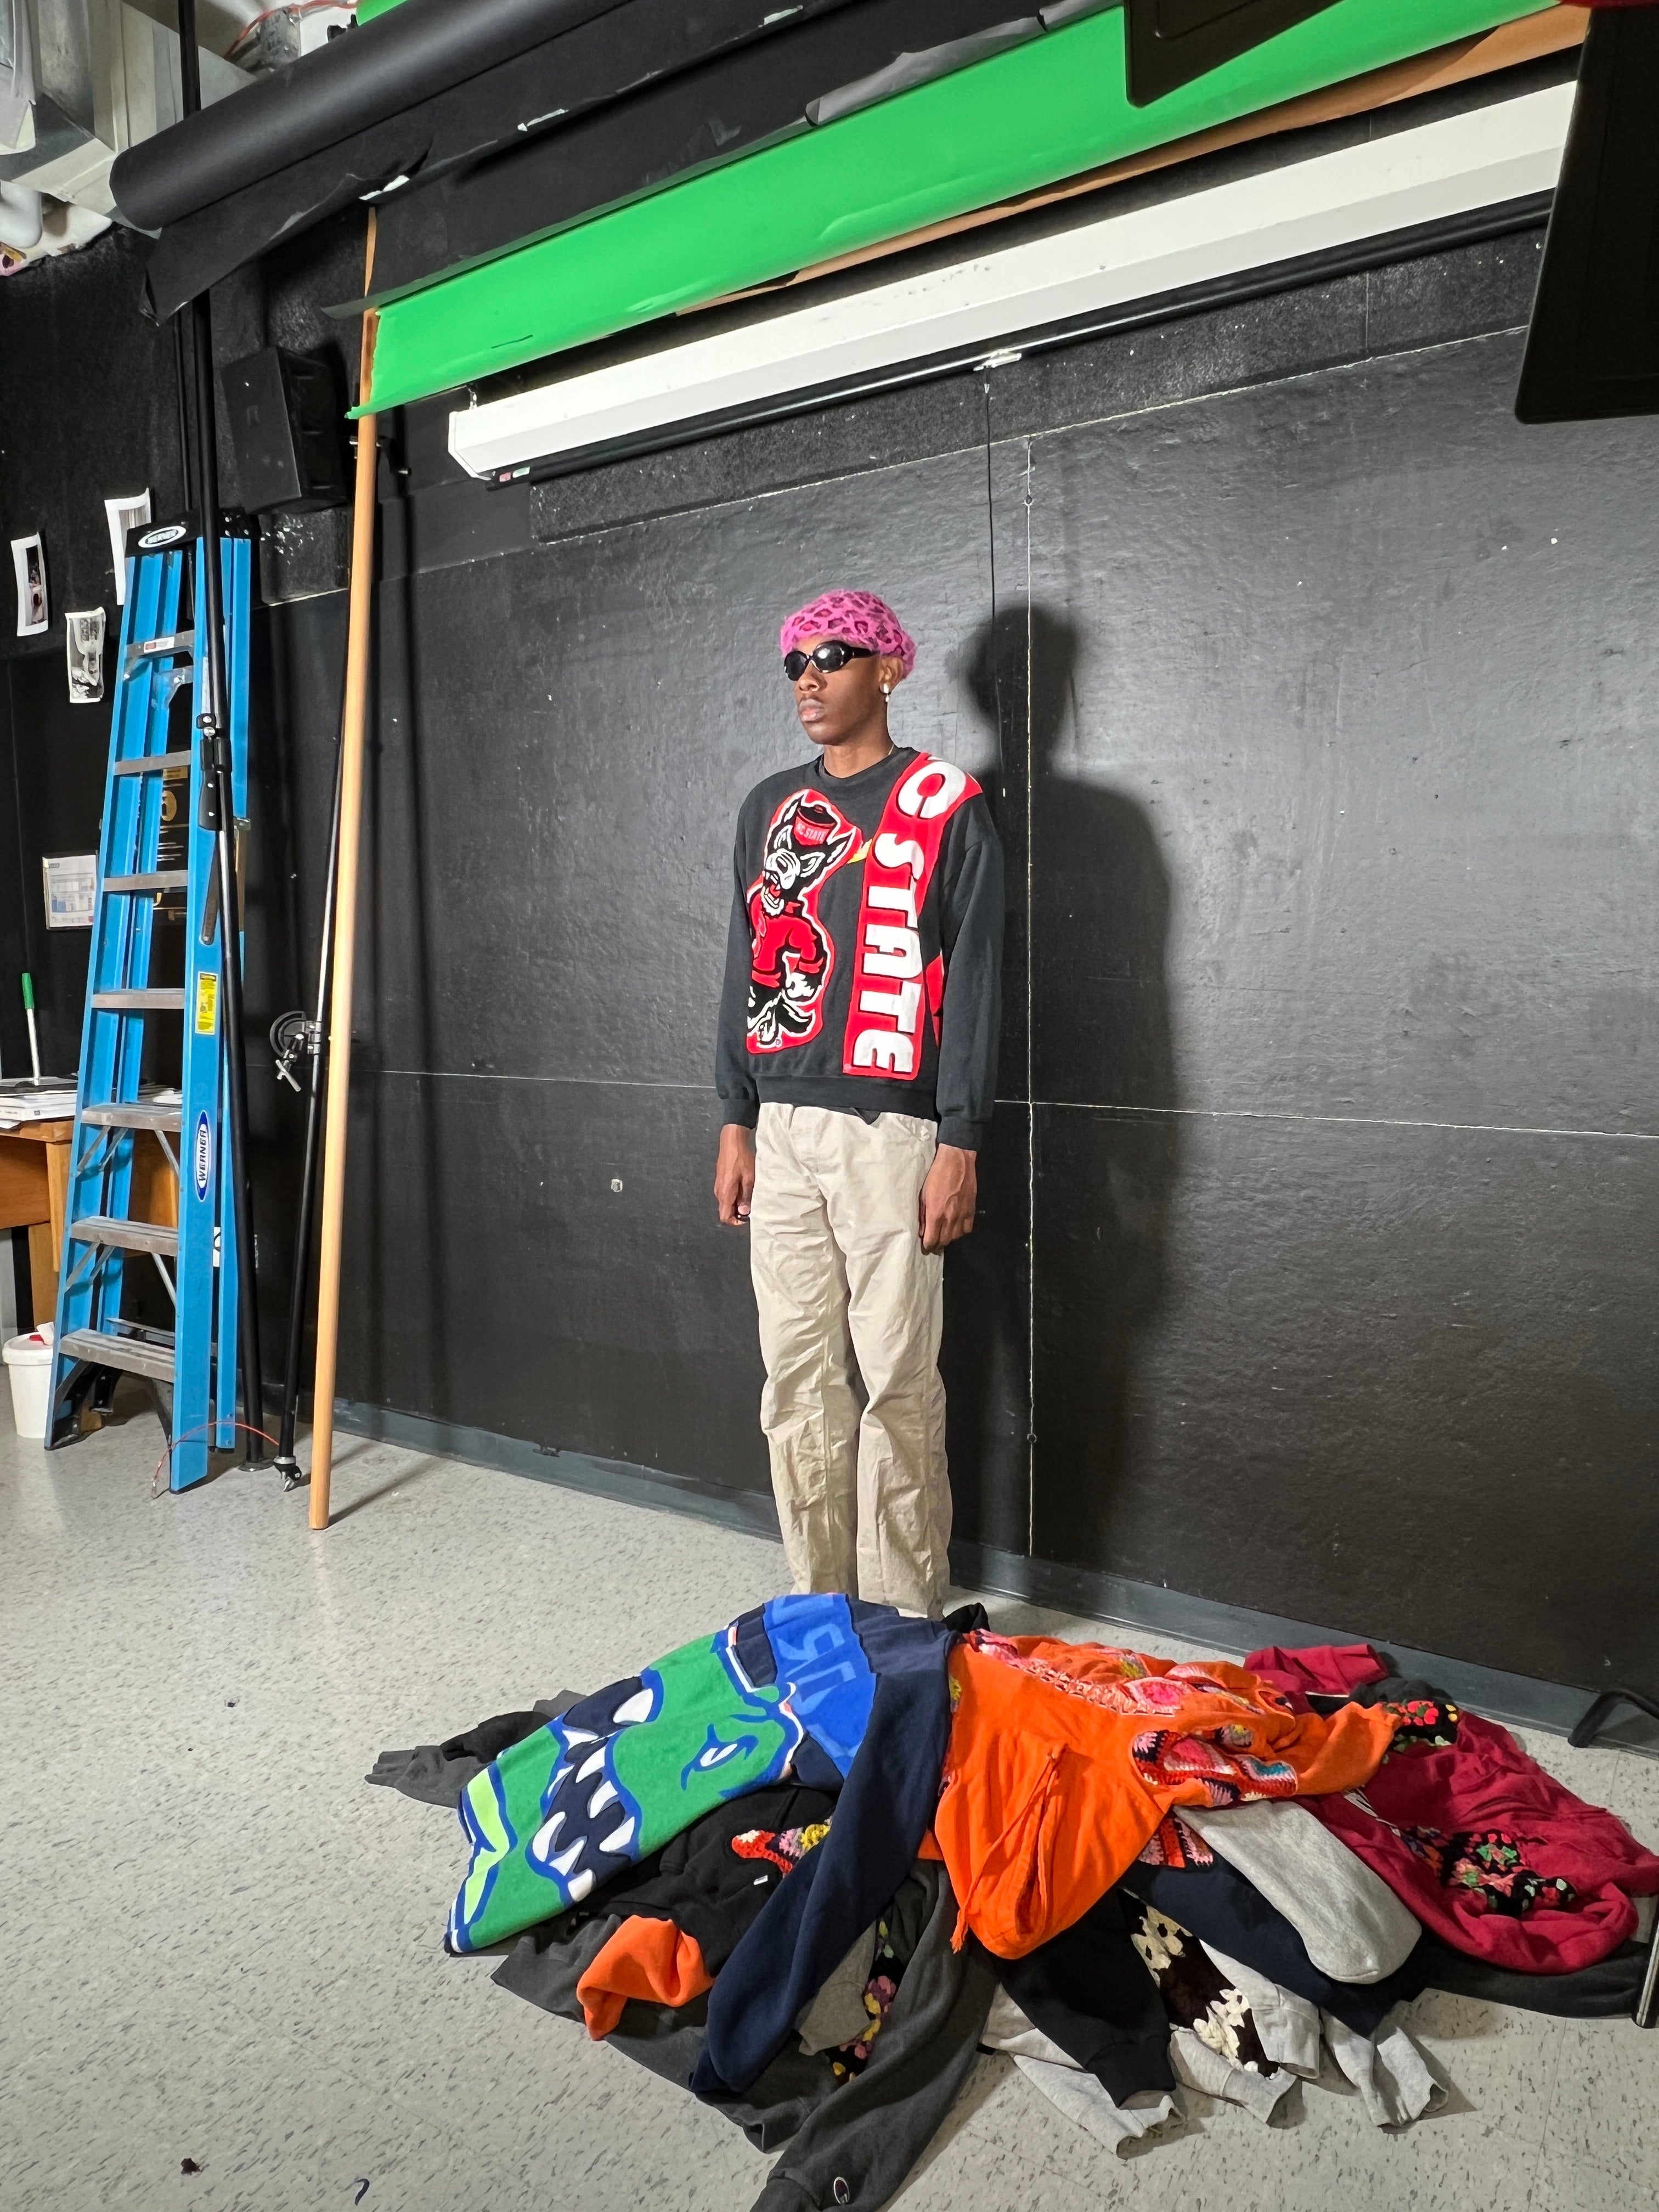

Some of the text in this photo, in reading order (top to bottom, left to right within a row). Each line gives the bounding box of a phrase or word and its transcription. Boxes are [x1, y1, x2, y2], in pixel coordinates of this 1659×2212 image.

[804, 828, 826, 843] STATE
[854, 757, 966, 1074] C STATE
